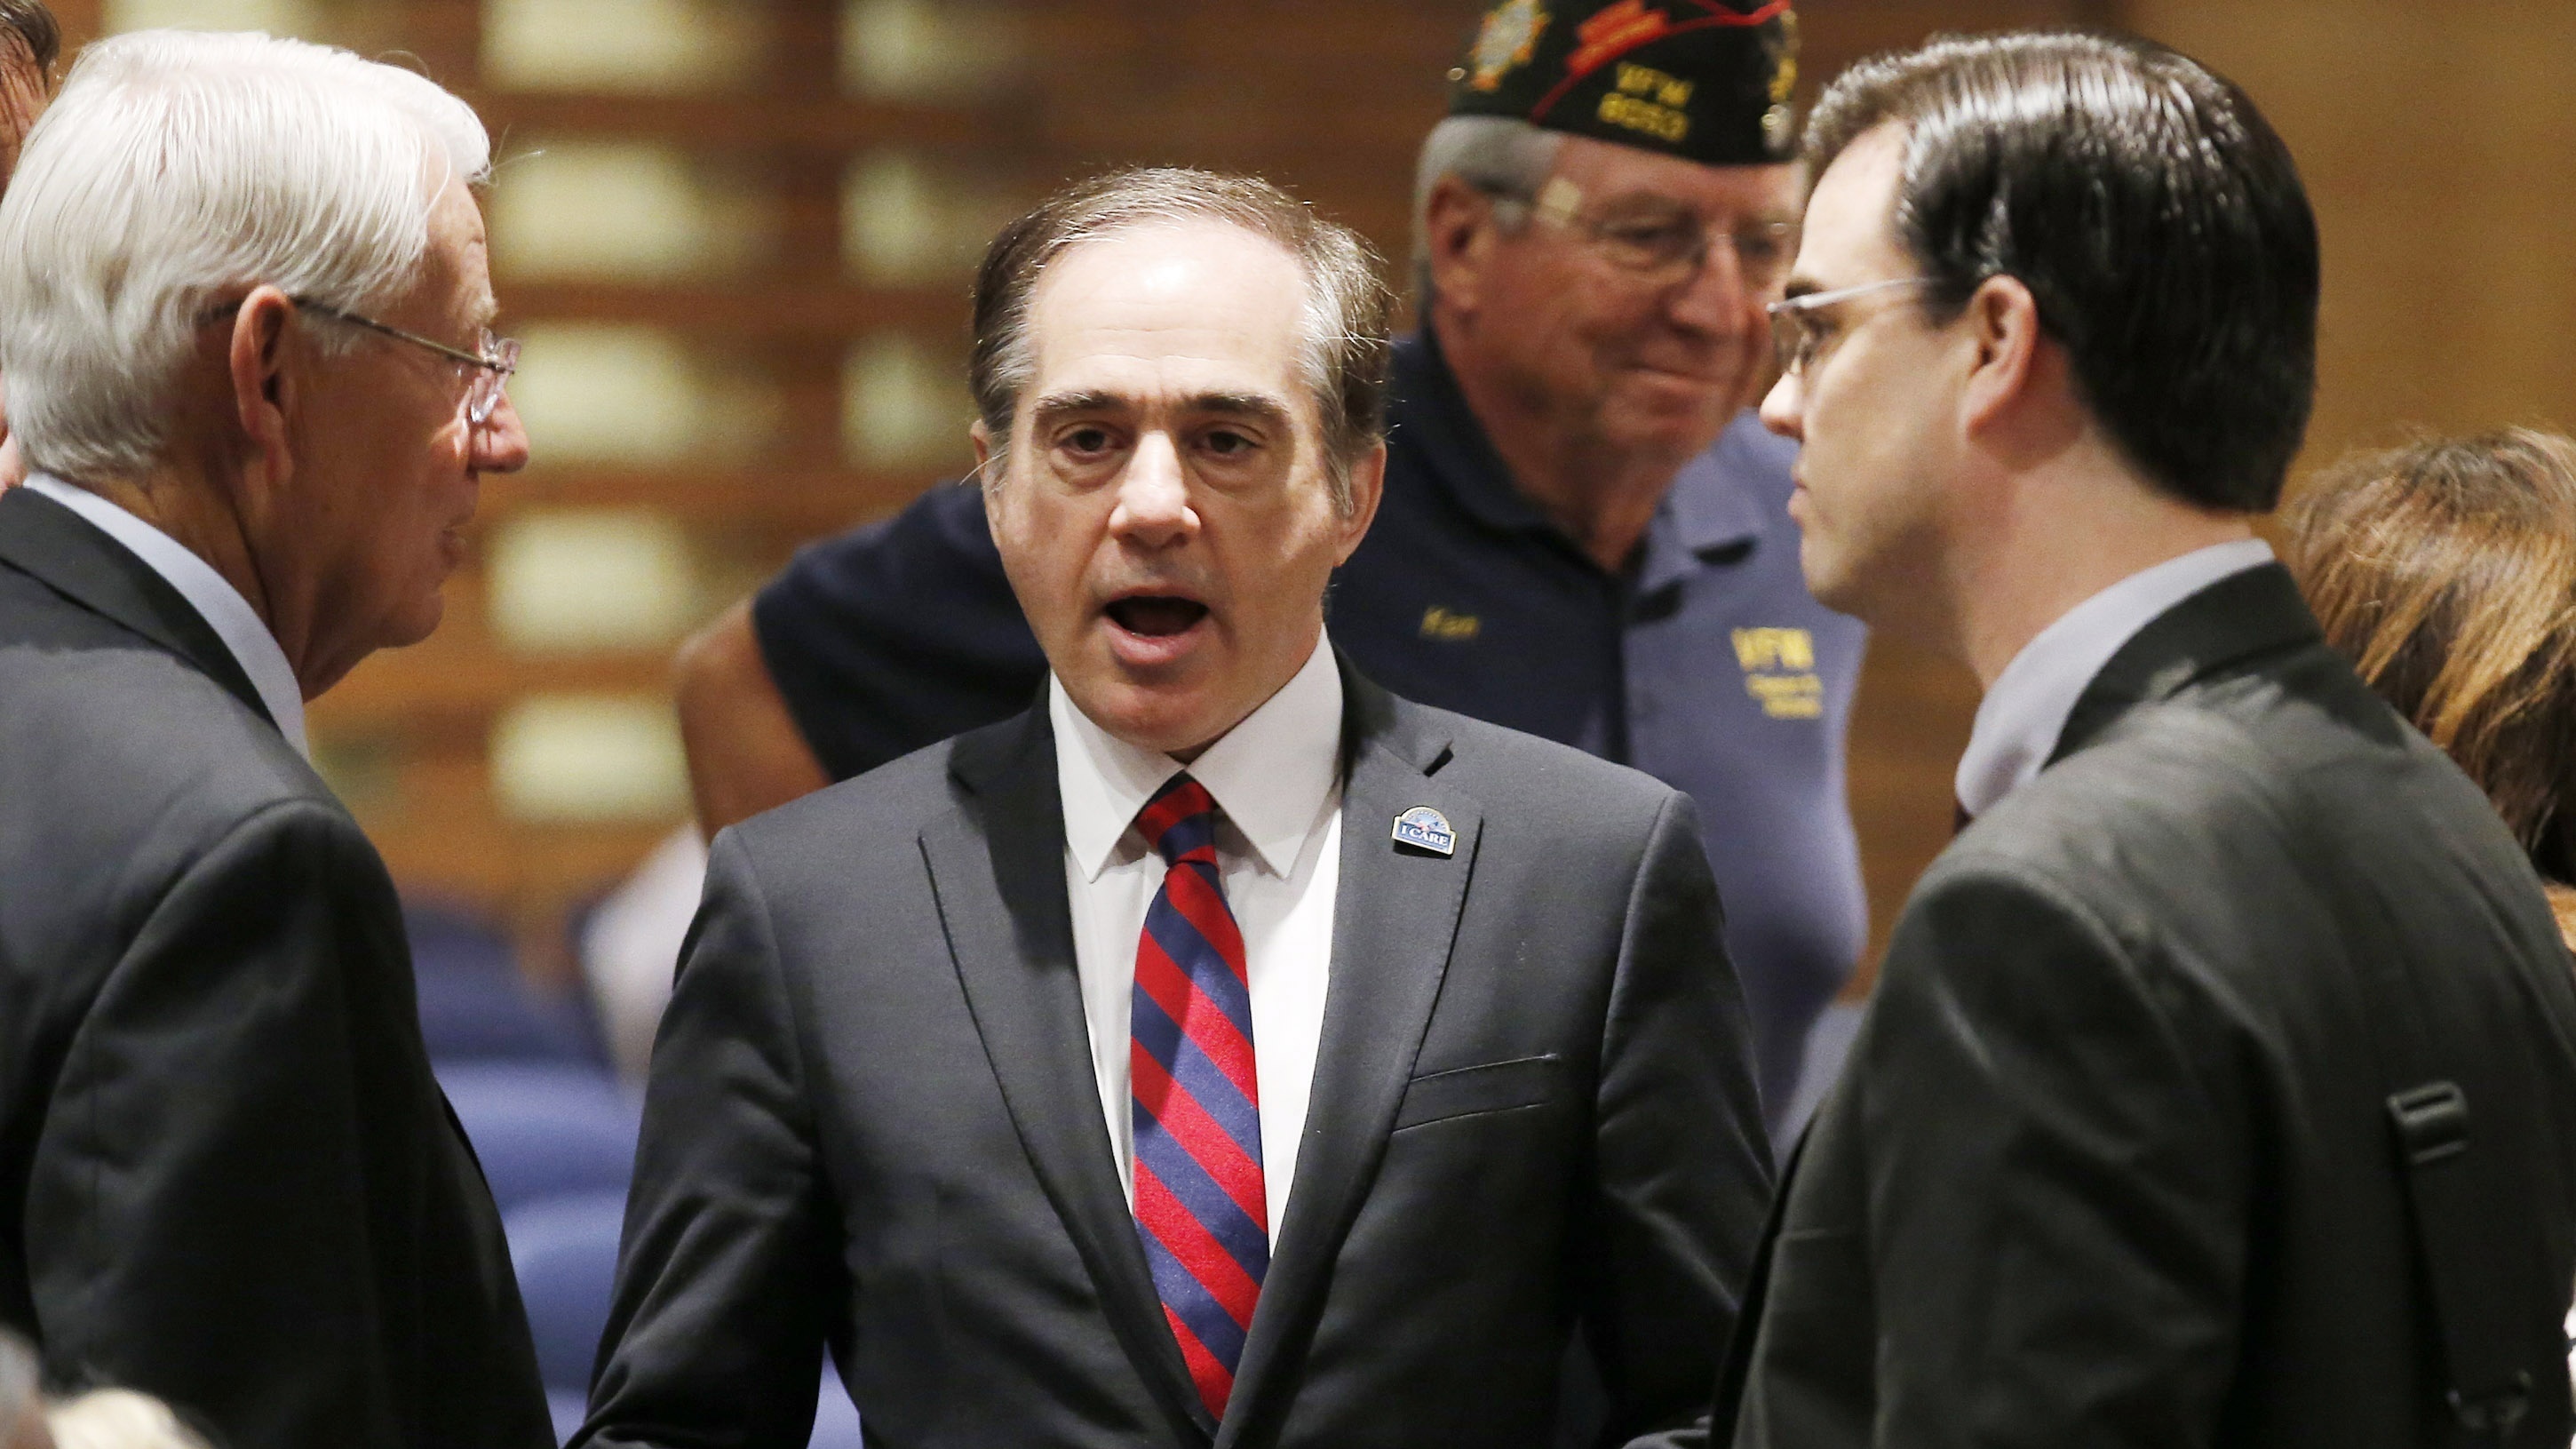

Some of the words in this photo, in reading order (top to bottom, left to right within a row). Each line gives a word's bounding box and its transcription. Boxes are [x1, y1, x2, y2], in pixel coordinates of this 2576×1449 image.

[1731, 627, 1814, 671] VFW
[1401, 824, 1407, 835] I
[1409, 828, 1449, 845] CARE
